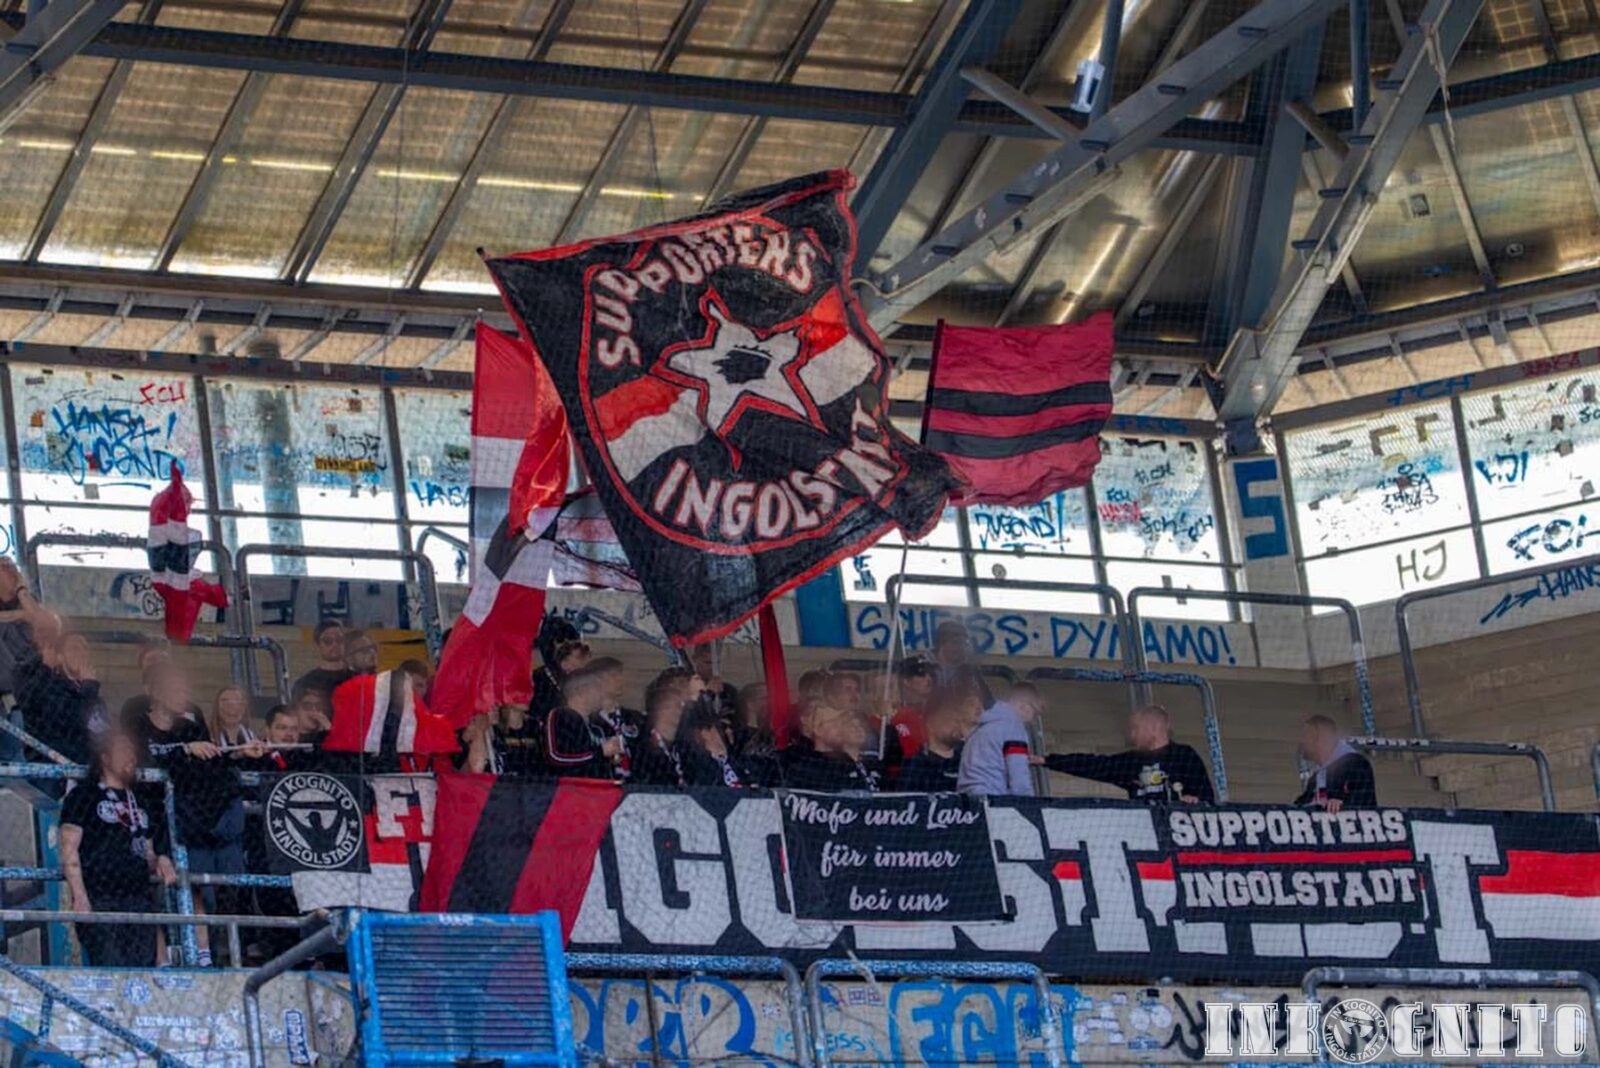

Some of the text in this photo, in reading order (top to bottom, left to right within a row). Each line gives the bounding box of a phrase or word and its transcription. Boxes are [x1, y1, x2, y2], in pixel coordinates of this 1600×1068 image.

[593, 222, 817, 369] SUPPORTERS
[1396, 540, 1447, 591] HJ
[286, 775, 354, 811] KOGNITO
[864, 801, 919, 825] und
[926, 799, 980, 830] Lars
[1169, 809, 1407, 847] SUPPORTERS
[275, 830, 359, 866] INGOLSTADT
[820, 841, 961, 877] für immer
[849, 886, 949, 912] bei uns
[1180, 868, 1417, 908] INGOLSTADT
